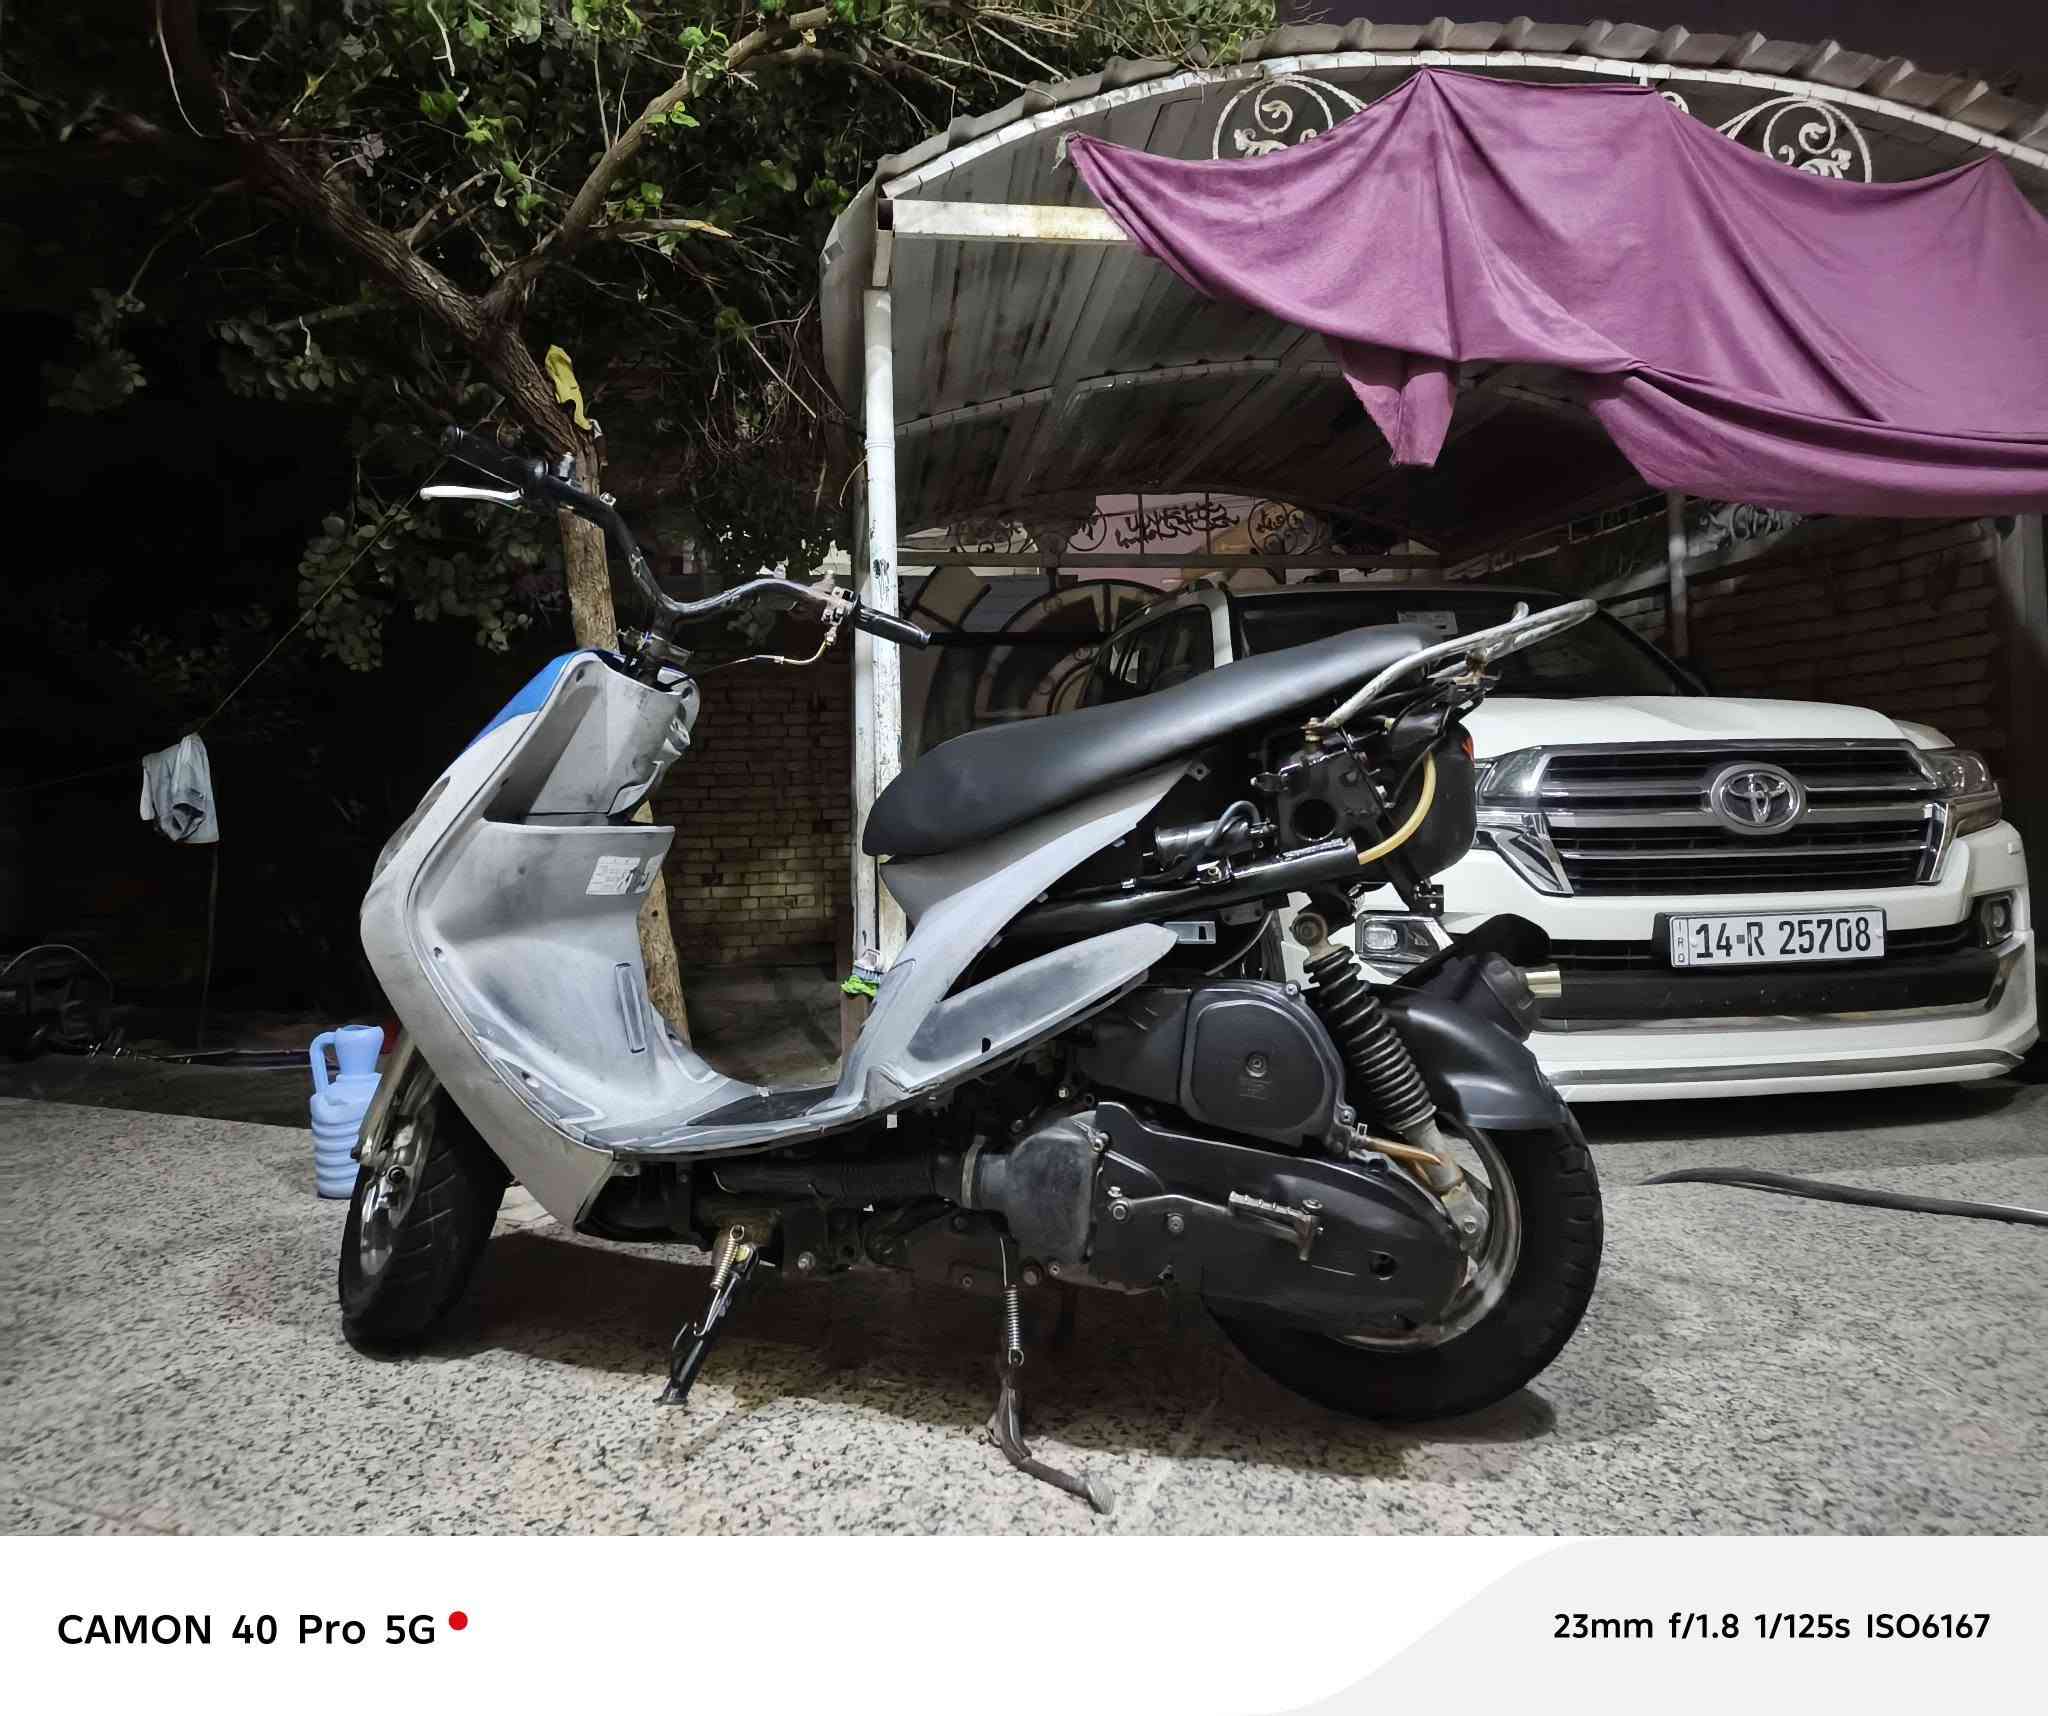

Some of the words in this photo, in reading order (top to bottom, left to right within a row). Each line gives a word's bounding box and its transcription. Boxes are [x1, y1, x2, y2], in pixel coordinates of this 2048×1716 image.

[1695, 922, 1733, 959] 14
[1747, 921, 1765, 957] R
[1778, 916, 1871, 955] 25708
